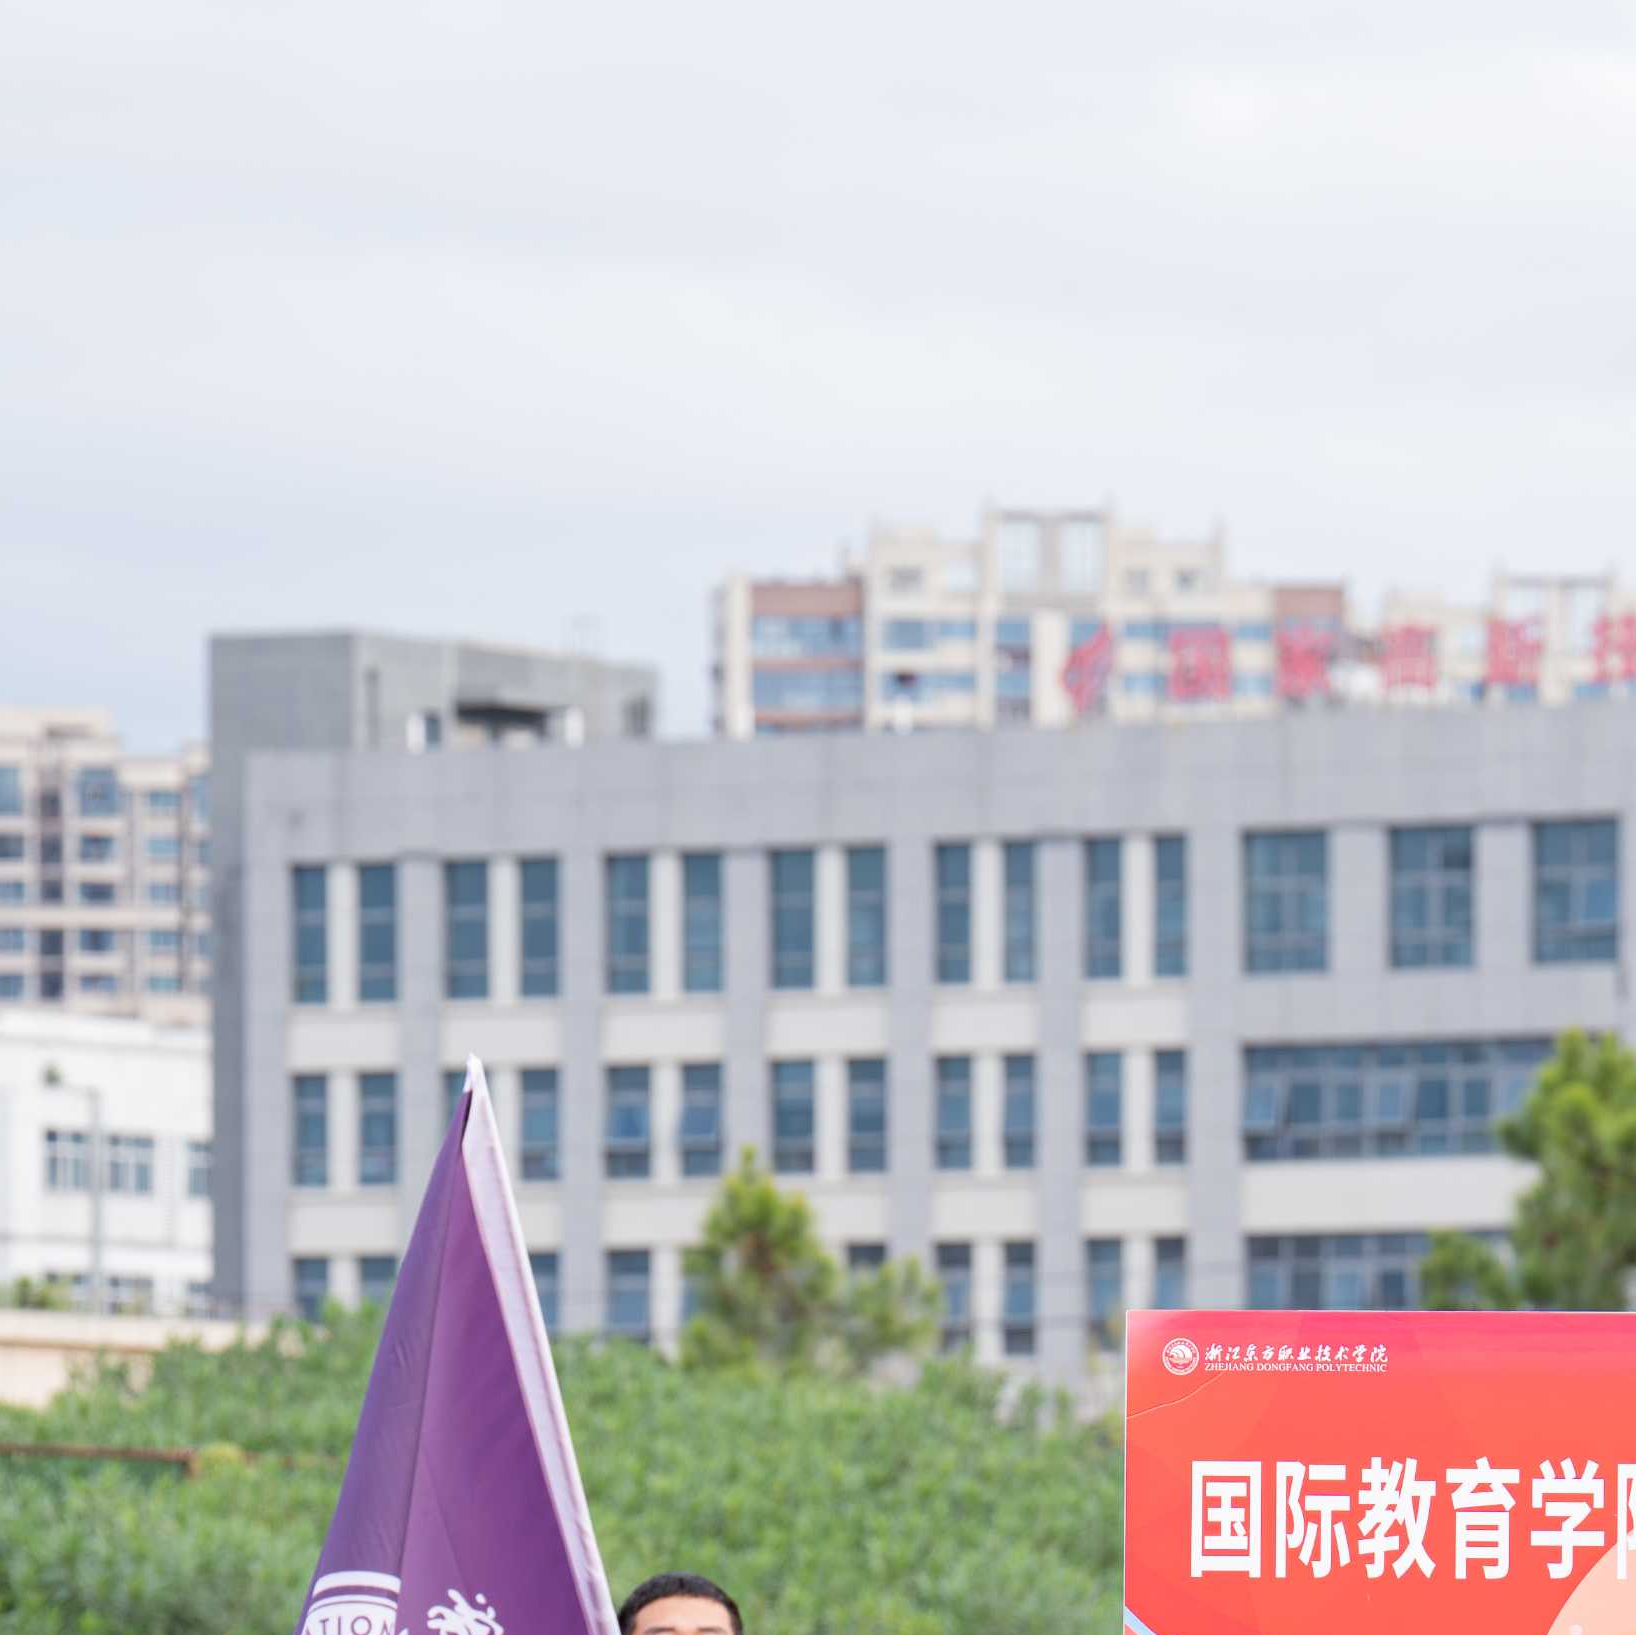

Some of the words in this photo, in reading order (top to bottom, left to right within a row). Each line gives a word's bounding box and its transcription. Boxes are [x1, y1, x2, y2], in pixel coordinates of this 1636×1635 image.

[1204, 1342, 1389, 1363] 浙江东方职业技术学院
[1204, 1362, 1254, 1372] ZHEJIANG
[1257, 1362, 1313, 1372] DONGFANG
[1316, 1362, 1387, 1373] POLYTECHNIC
